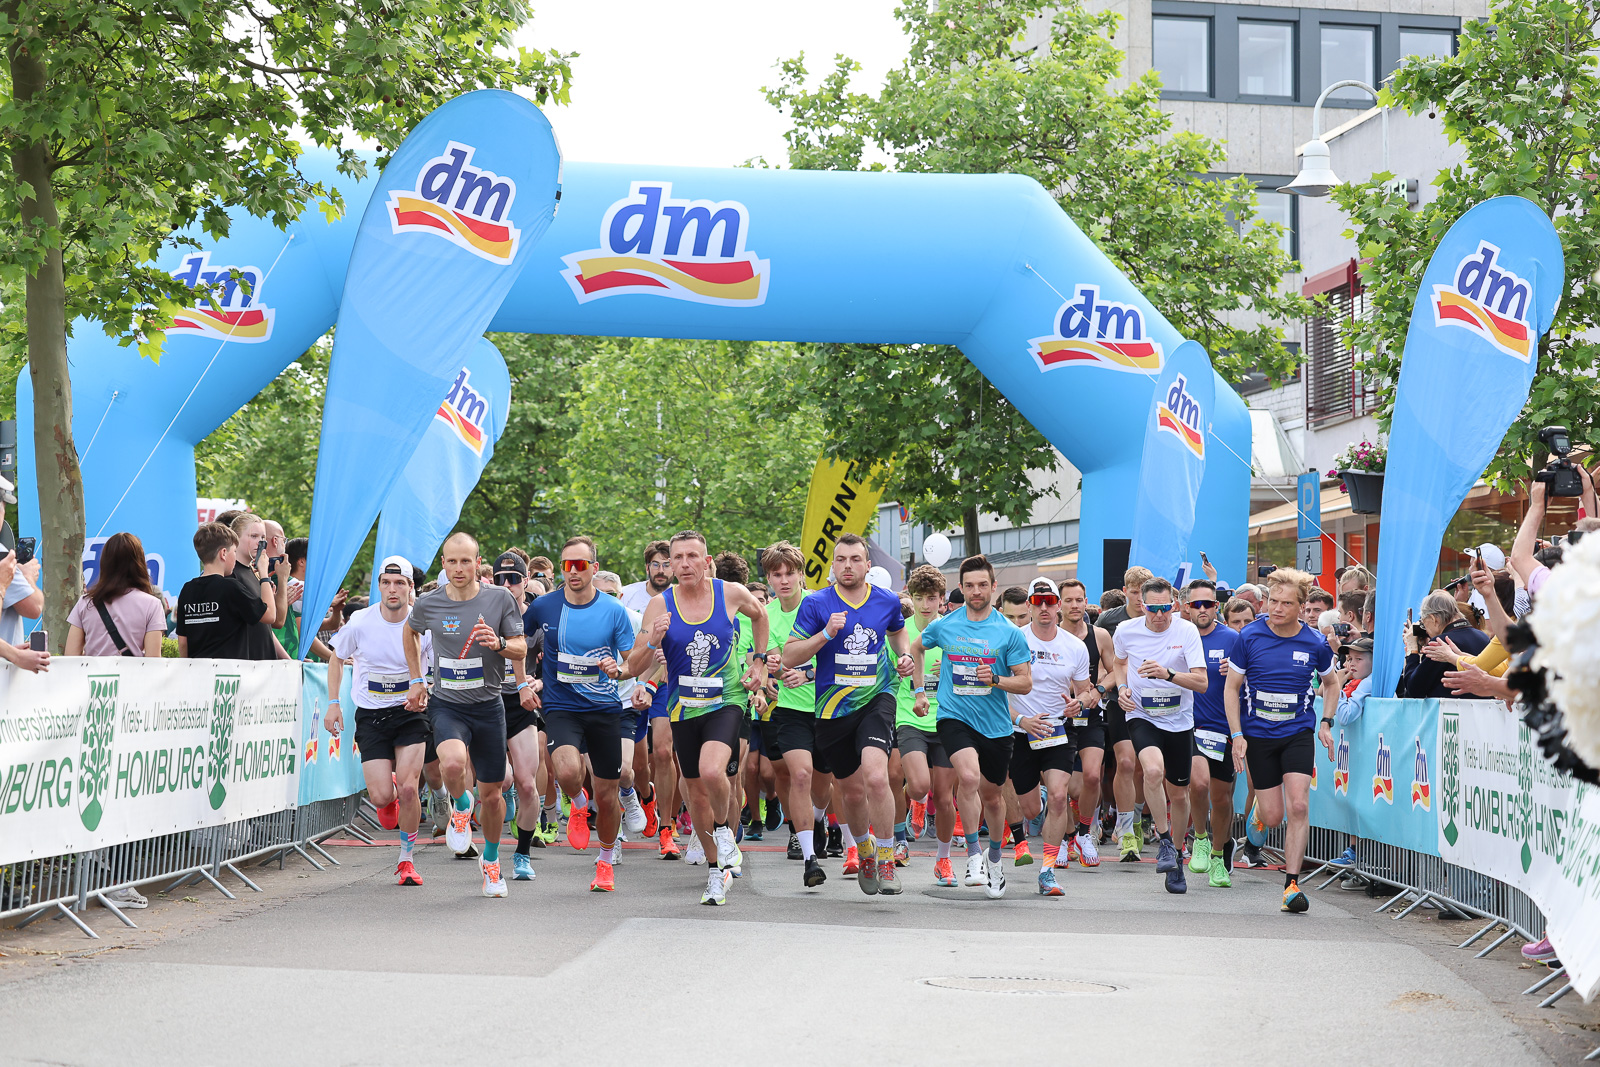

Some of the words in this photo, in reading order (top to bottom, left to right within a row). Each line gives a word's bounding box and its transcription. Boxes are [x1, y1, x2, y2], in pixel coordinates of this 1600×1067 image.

[421, 148, 511, 222] dm
[609, 187, 741, 258] dm
[1458, 247, 1528, 321] dm
[1059, 289, 1141, 341] dm
[1168, 377, 1199, 431] dm
[1303, 482, 1315, 531] P
[568, 663, 588, 671] Marco
[845, 664, 868, 672] Jeremy
[121, 703, 142, 734] Kreis-
[152, 701, 209, 732] Universitätsstadt
[1263, 701, 1289, 709] Matthias
[1202, 739, 1217, 747] Oliver
[1337, 733, 1349, 771] dm
[1376, 737, 1391, 777] dm
[1415, 740, 1428, 782] dm
[115, 745, 205, 800] HOMBURG
[1464, 785, 1520, 842] HOMBURG
